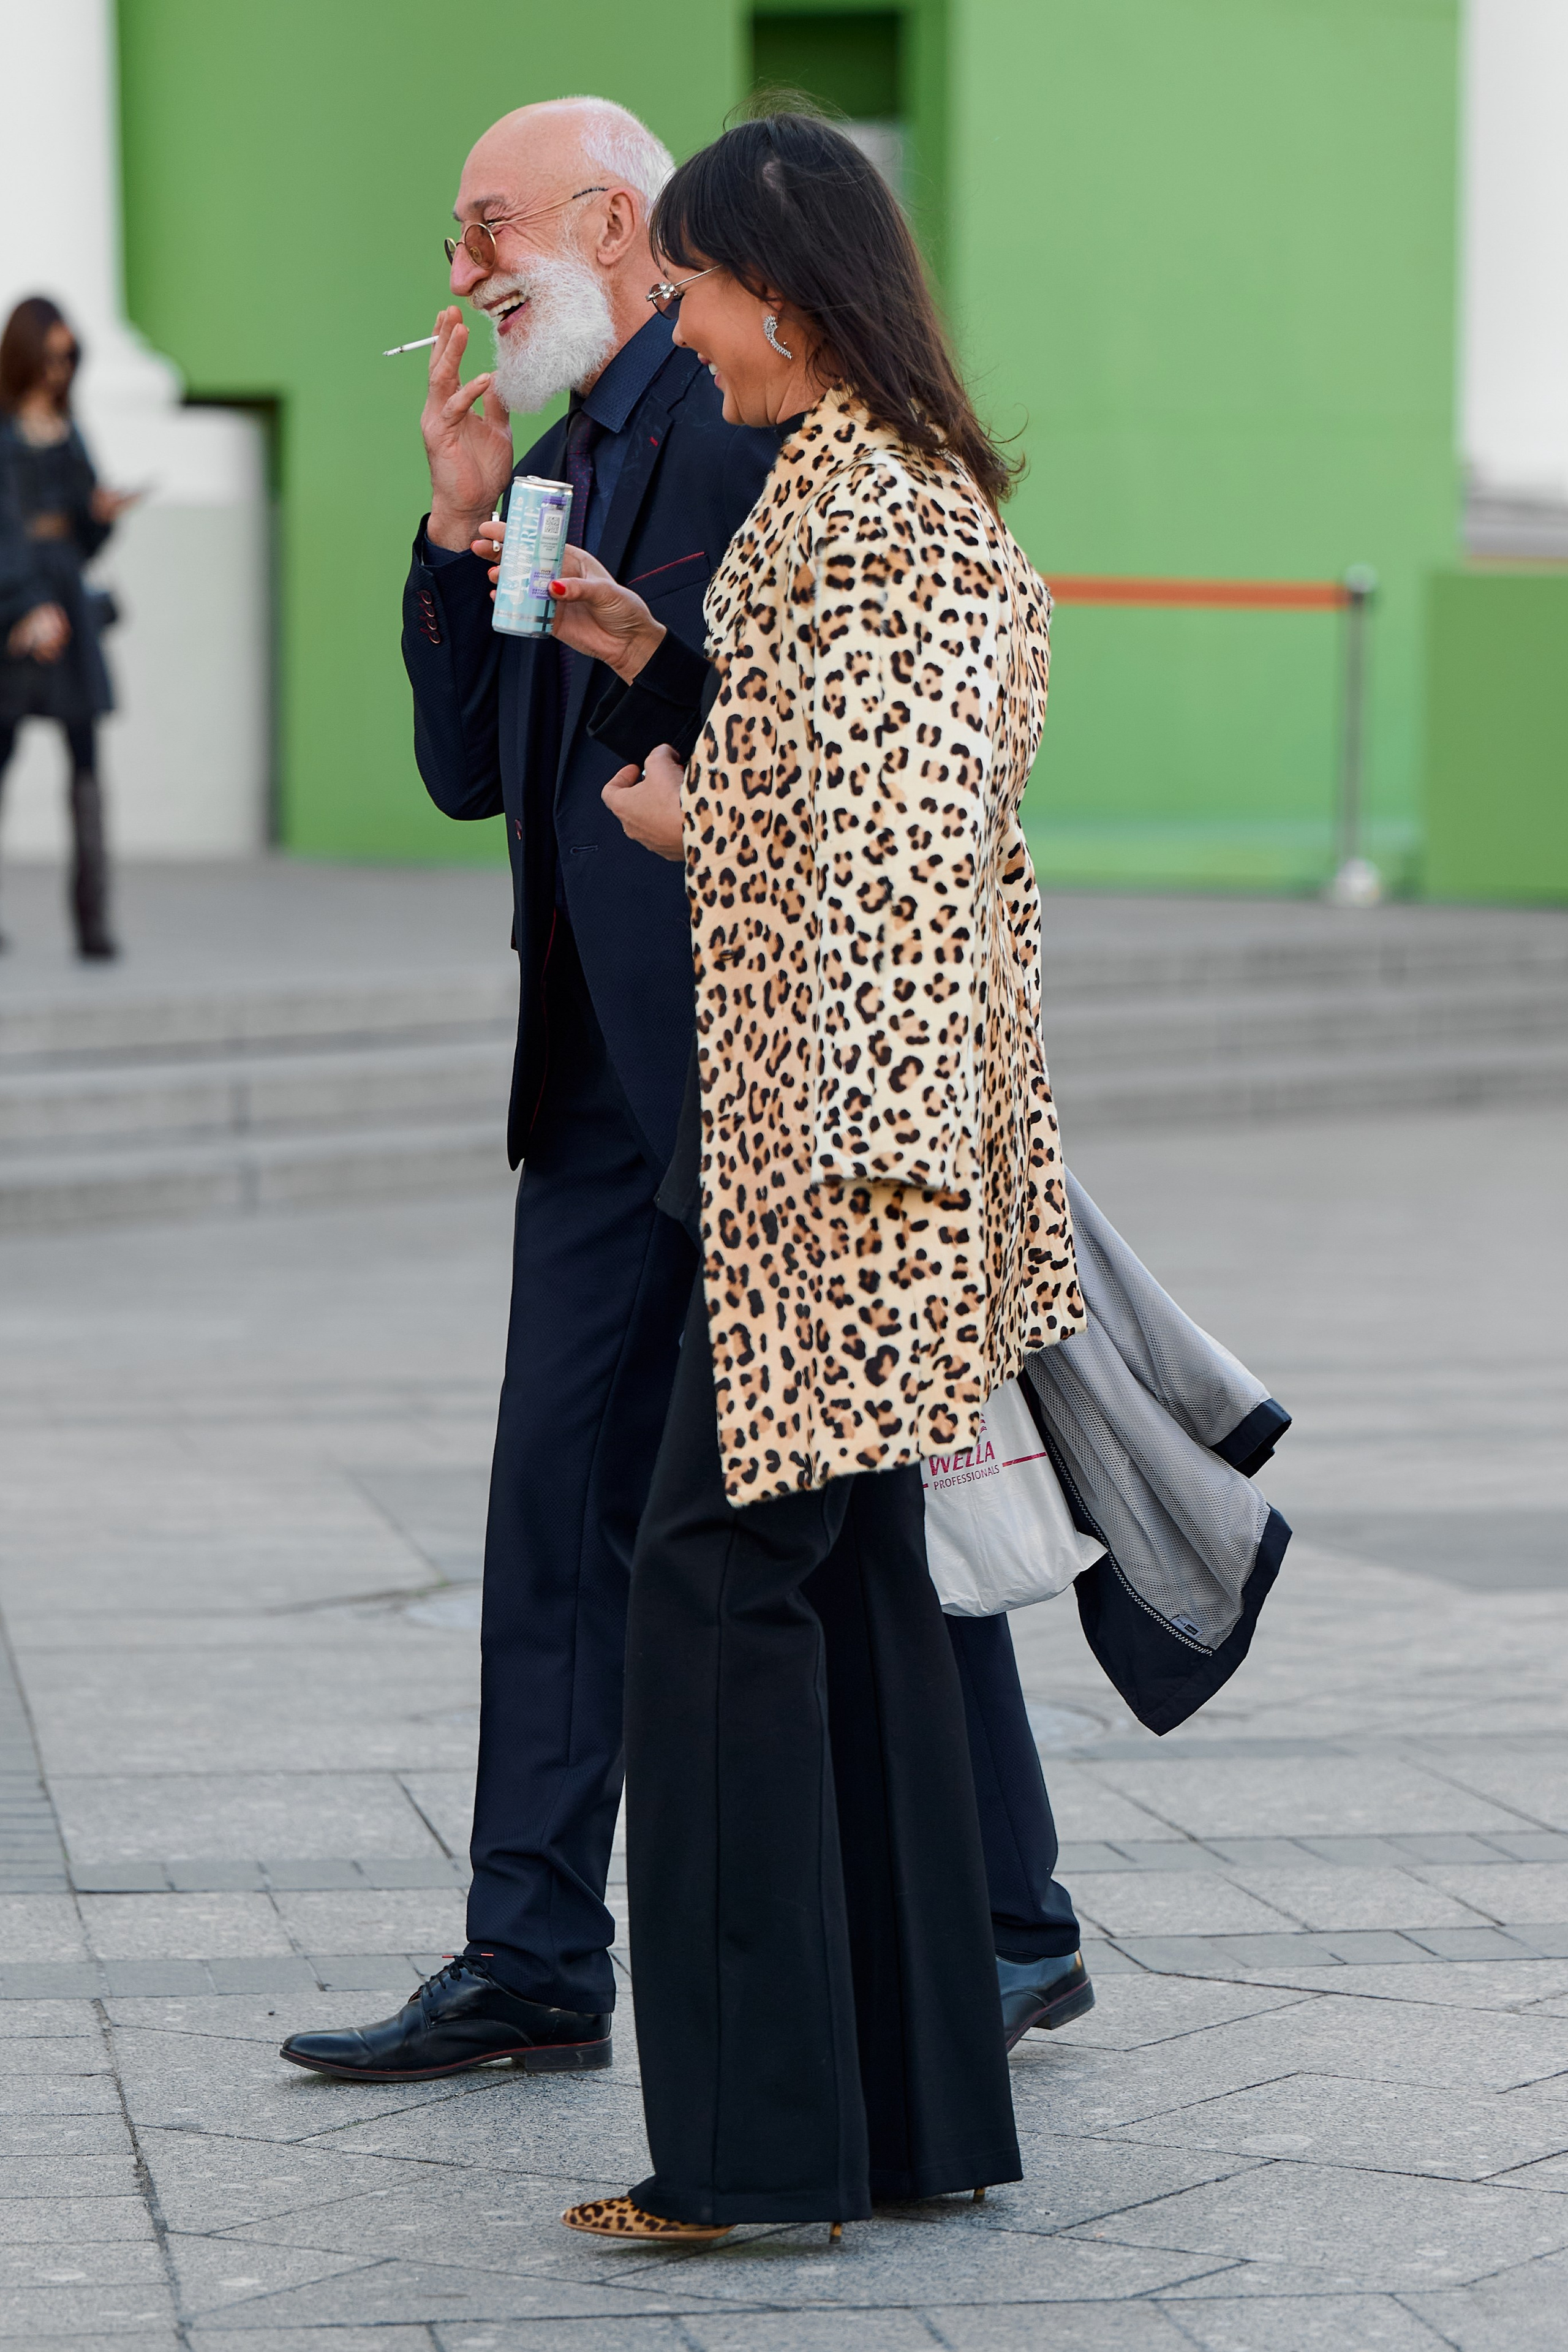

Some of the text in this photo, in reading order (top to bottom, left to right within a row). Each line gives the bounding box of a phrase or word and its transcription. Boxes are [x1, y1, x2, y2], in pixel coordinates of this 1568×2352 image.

[517, 507, 540, 567] PERLE
[929, 1441, 995, 1476] WELLA
[933, 1464, 1000, 1490] PROFESSIONALS
